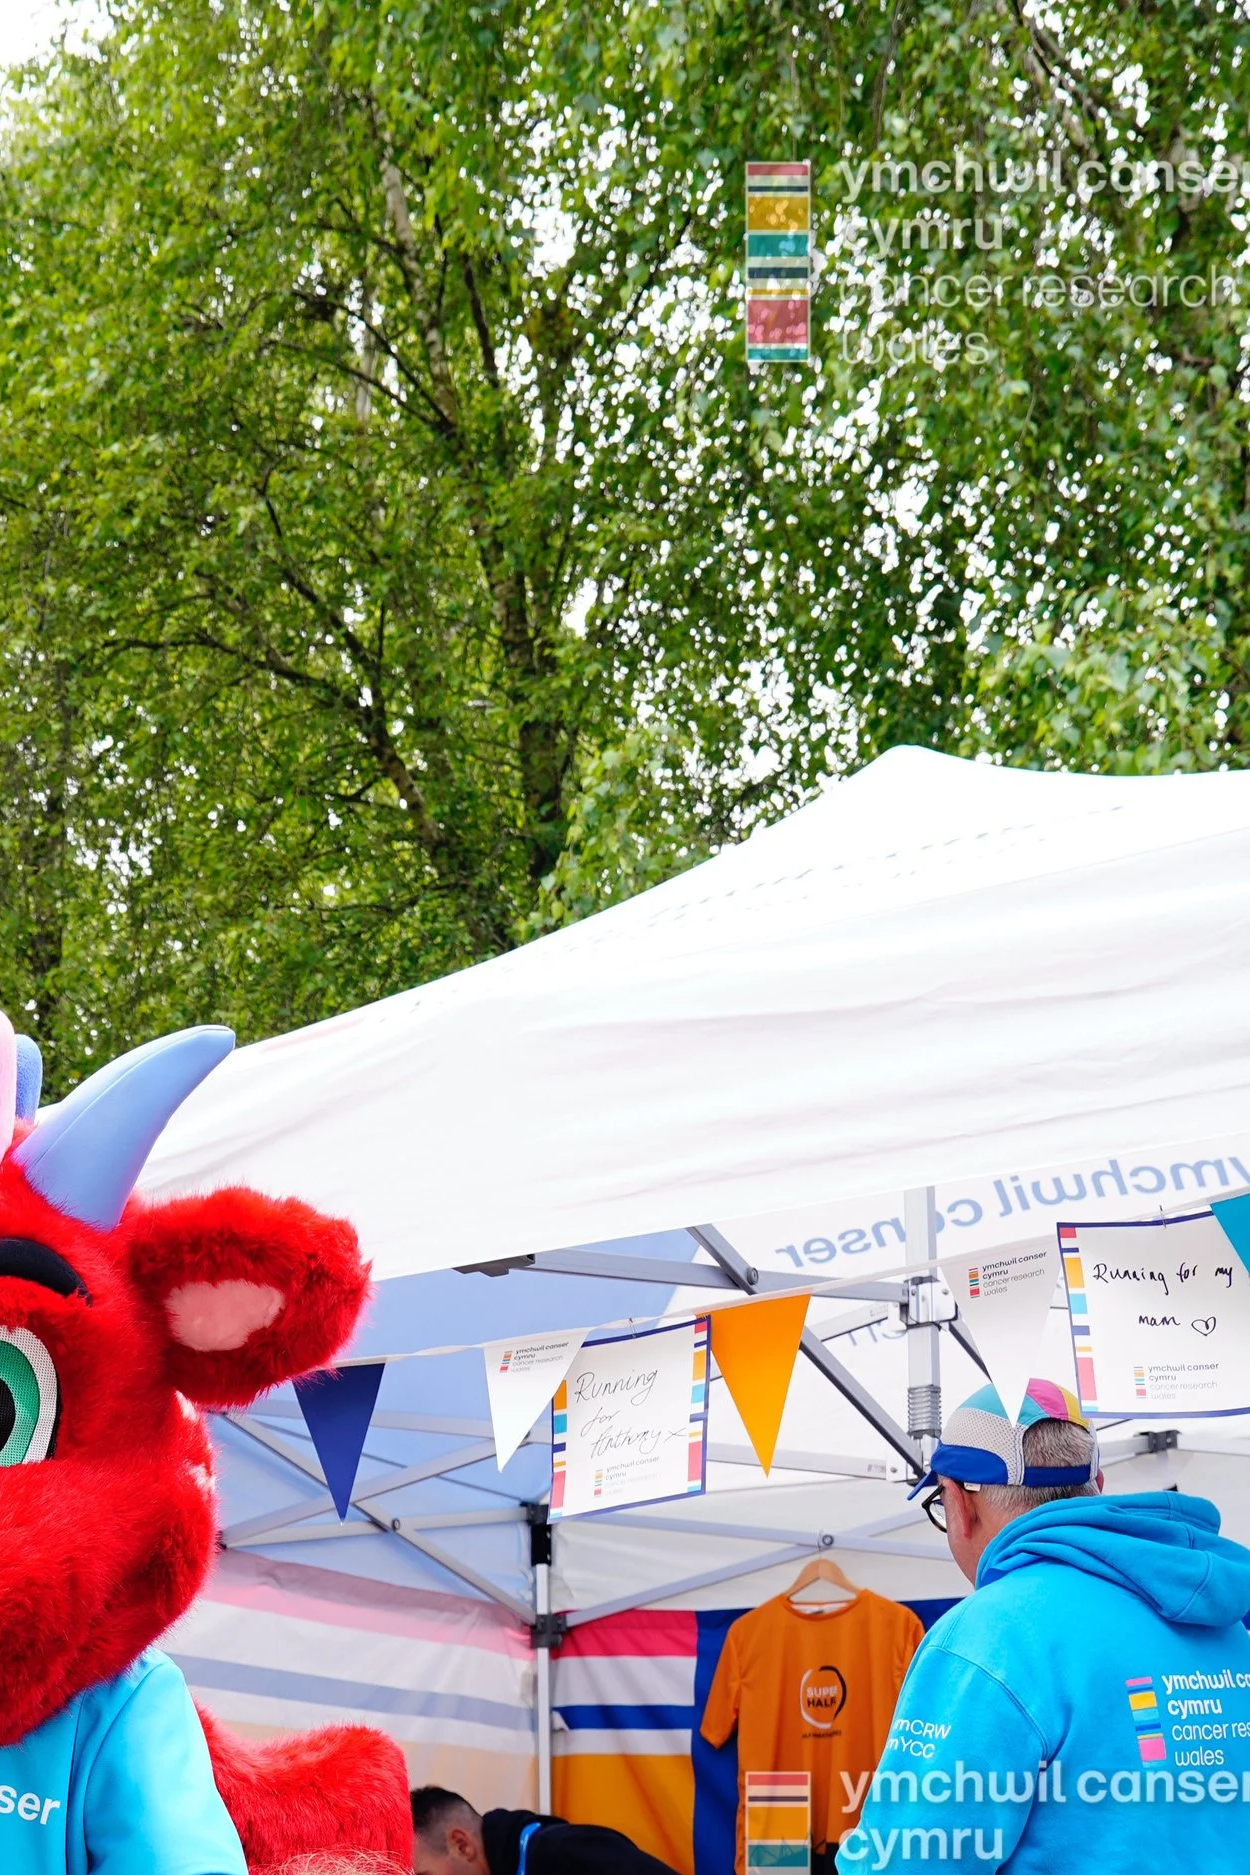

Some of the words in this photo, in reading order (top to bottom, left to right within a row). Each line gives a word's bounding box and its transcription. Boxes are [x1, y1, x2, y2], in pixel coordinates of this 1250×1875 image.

[982, 1257, 1017, 1272] ymchwil
[1018, 1251, 1047, 1263] canser
[982, 1269, 1009, 1280] cymru
[983, 1277, 1010, 1288] cancer
[1011, 1268, 1045, 1281] research
[1093, 1262, 1169, 1296] Running
[1176, 1262, 1198, 1283] for
[1215, 1266, 1233, 1288] my
[984, 1286, 1007, 1296] wales
[1148, 1363, 1186, 1373] ymchwil
[1187, 1362, 1219, 1371] canser
[574, 1369, 658, 1406] Running
[1161, 1669, 1236, 1694] ymchwil
[1167, 1698, 1223, 1719] cymru
[1172, 1723, 1228, 1741] cancer
[1175, 1746, 1224, 1766] wales
